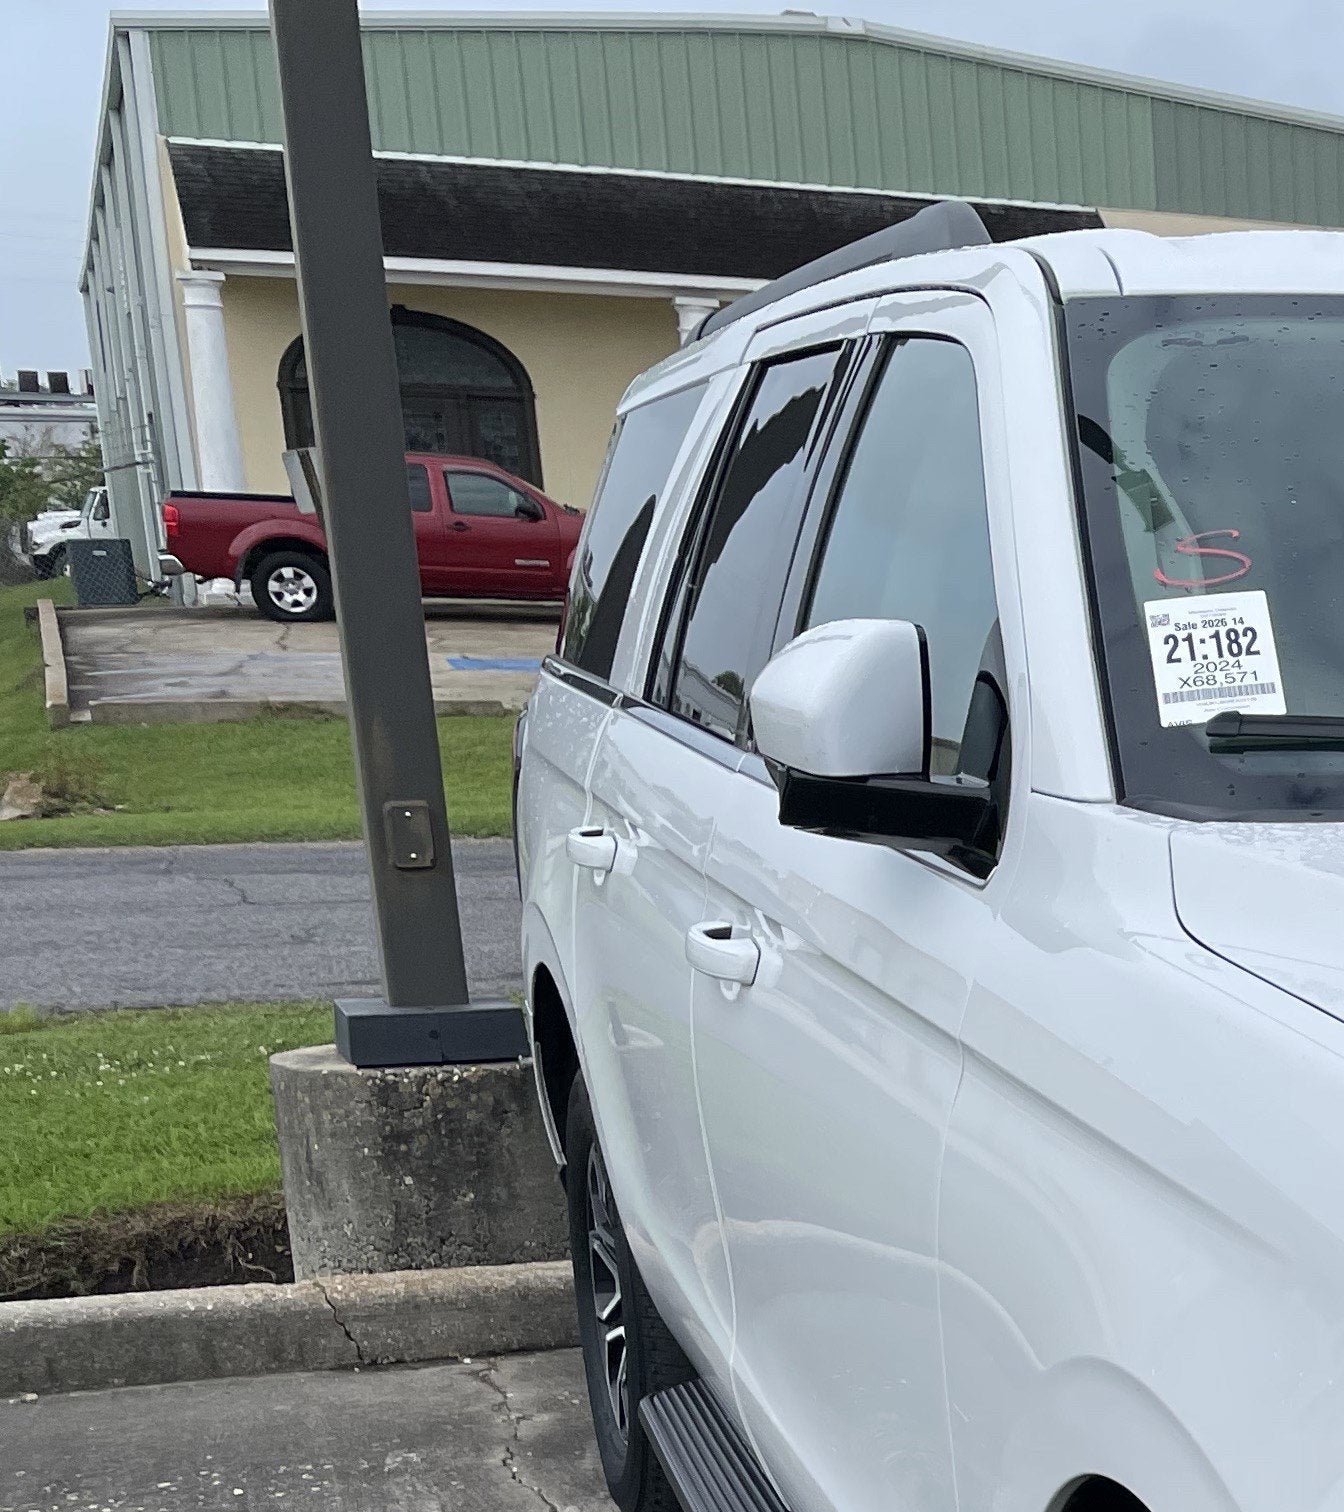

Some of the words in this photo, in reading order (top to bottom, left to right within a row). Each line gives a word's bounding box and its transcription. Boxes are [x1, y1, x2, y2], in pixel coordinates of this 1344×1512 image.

[1174, 618, 1198, 632] Sale
[1201, 617, 1228, 629] 2026
[1232, 616, 1245, 626] 14
[1163, 627, 1261, 664] 21:182
[1193, 659, 1244, 675] 2024
[1178, 670, 1259, 689] X68,571
